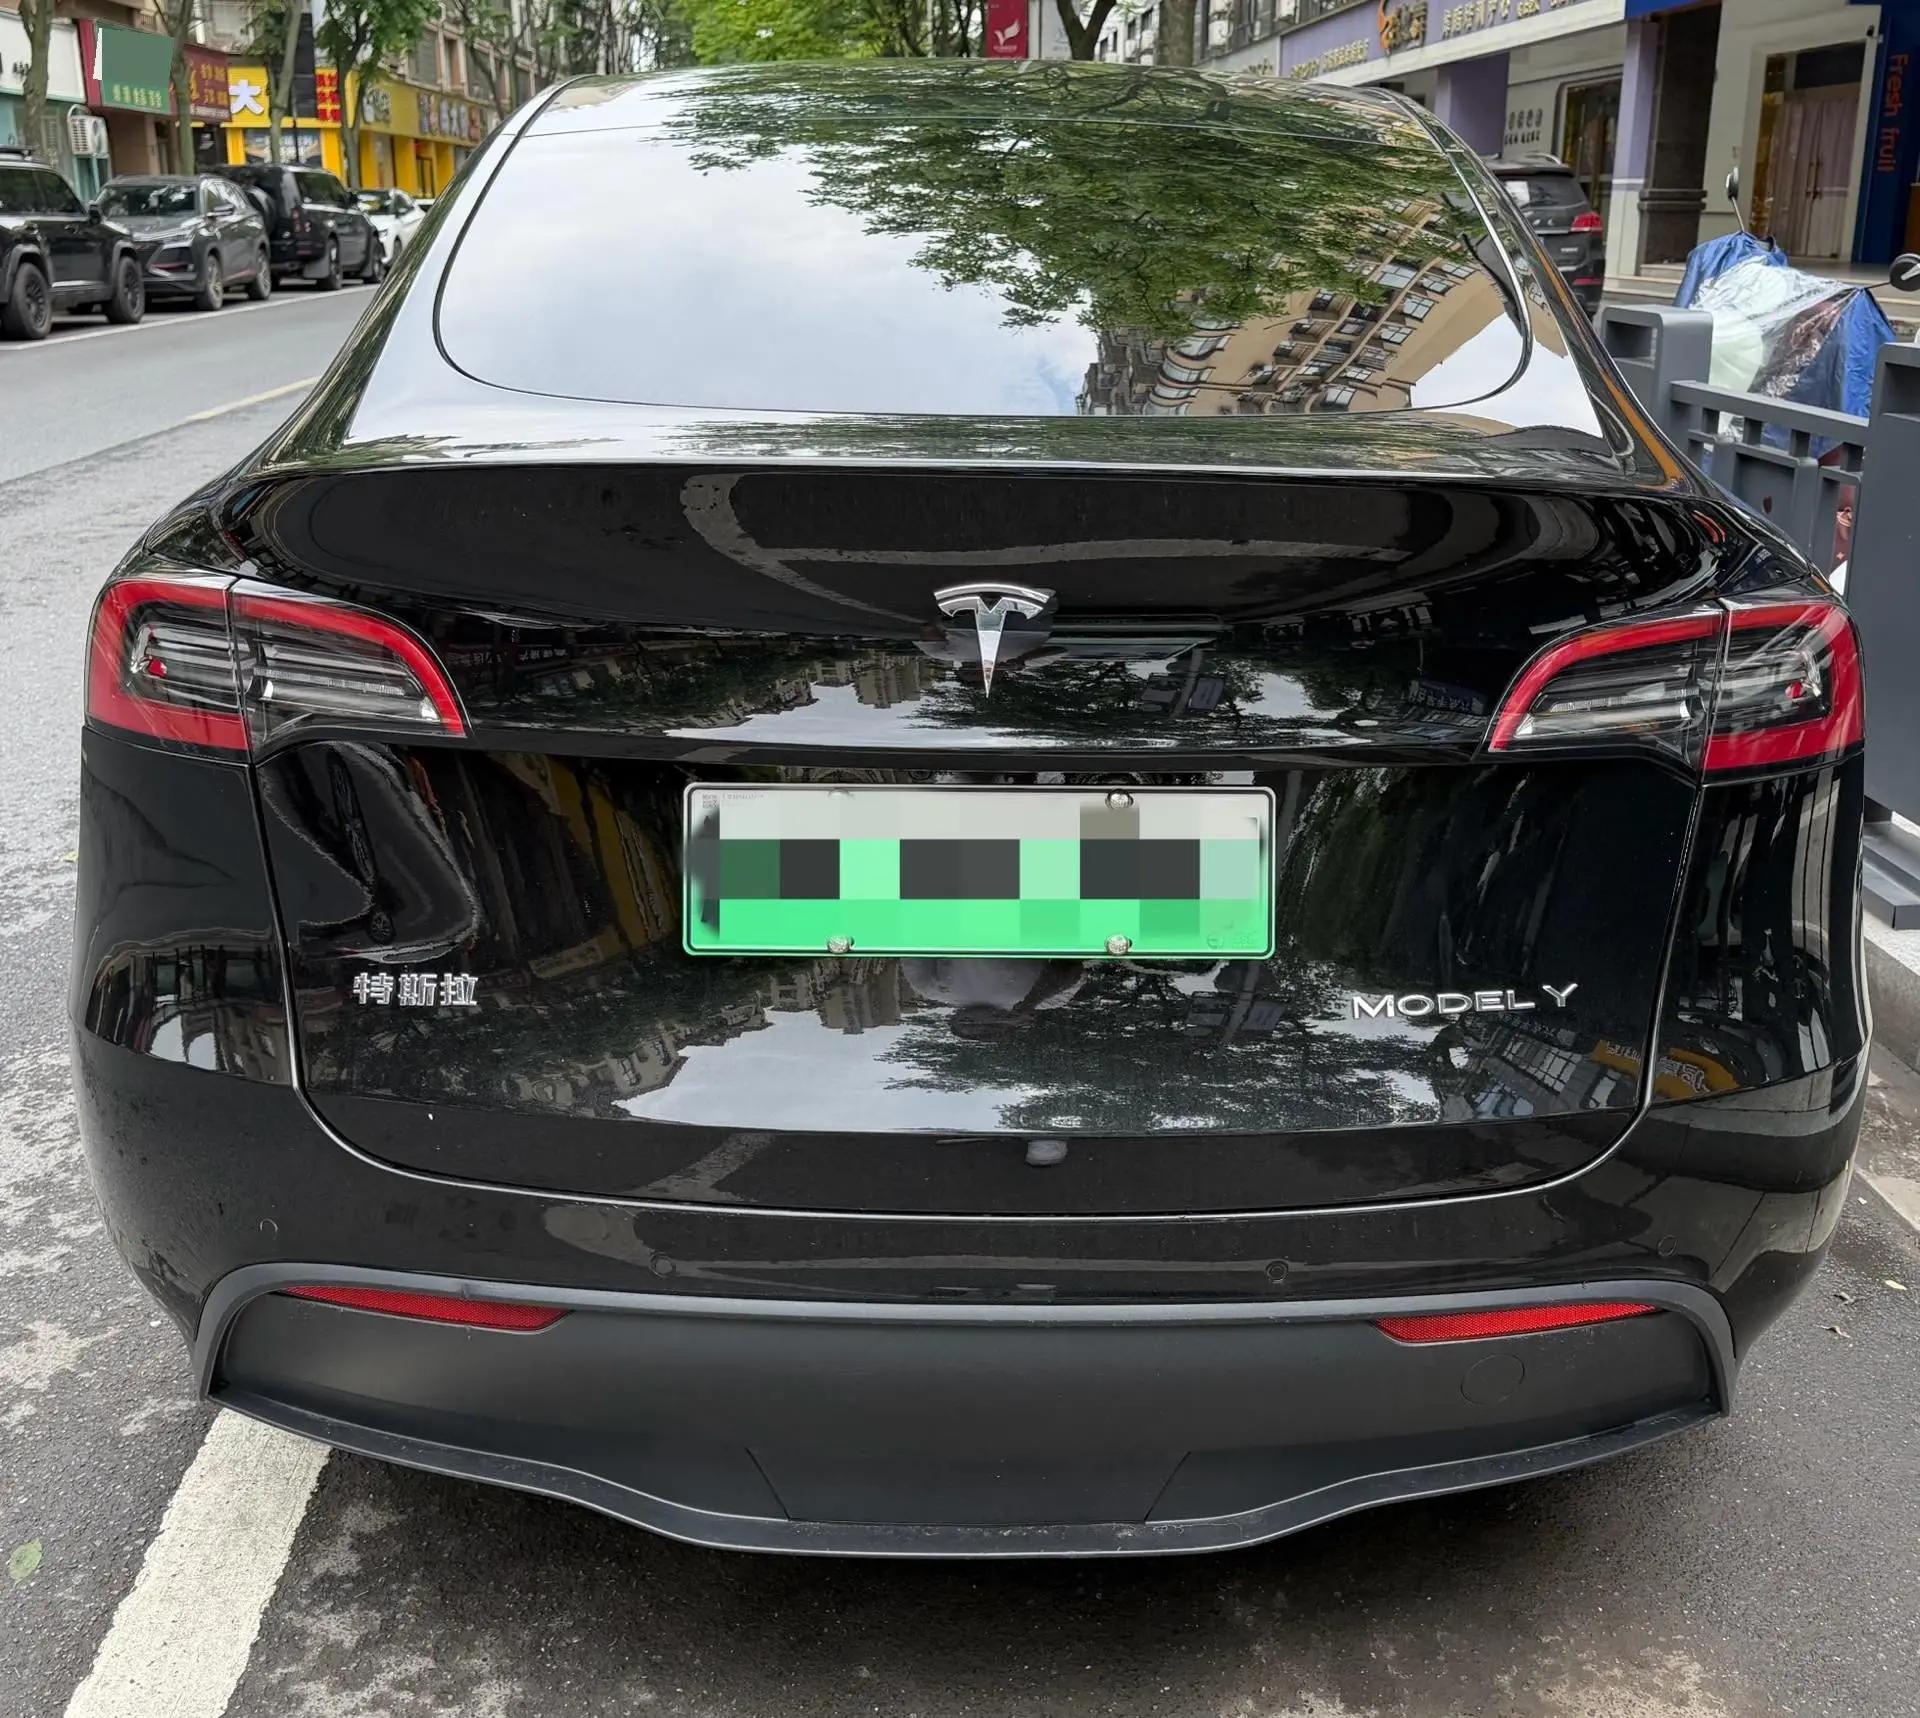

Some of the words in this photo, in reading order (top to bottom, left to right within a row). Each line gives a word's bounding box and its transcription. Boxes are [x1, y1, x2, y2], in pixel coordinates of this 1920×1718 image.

[228, 78, 264, 115] 大
[1883, 54, 1908, 117] Fresh
[1877, 128, 1900, 172] fruit
[353, 972, 479, 1006] 特斯拉
[1352, 990, 1536, 1019] MODEL
[1542, 983, 1578, 1008] Y
